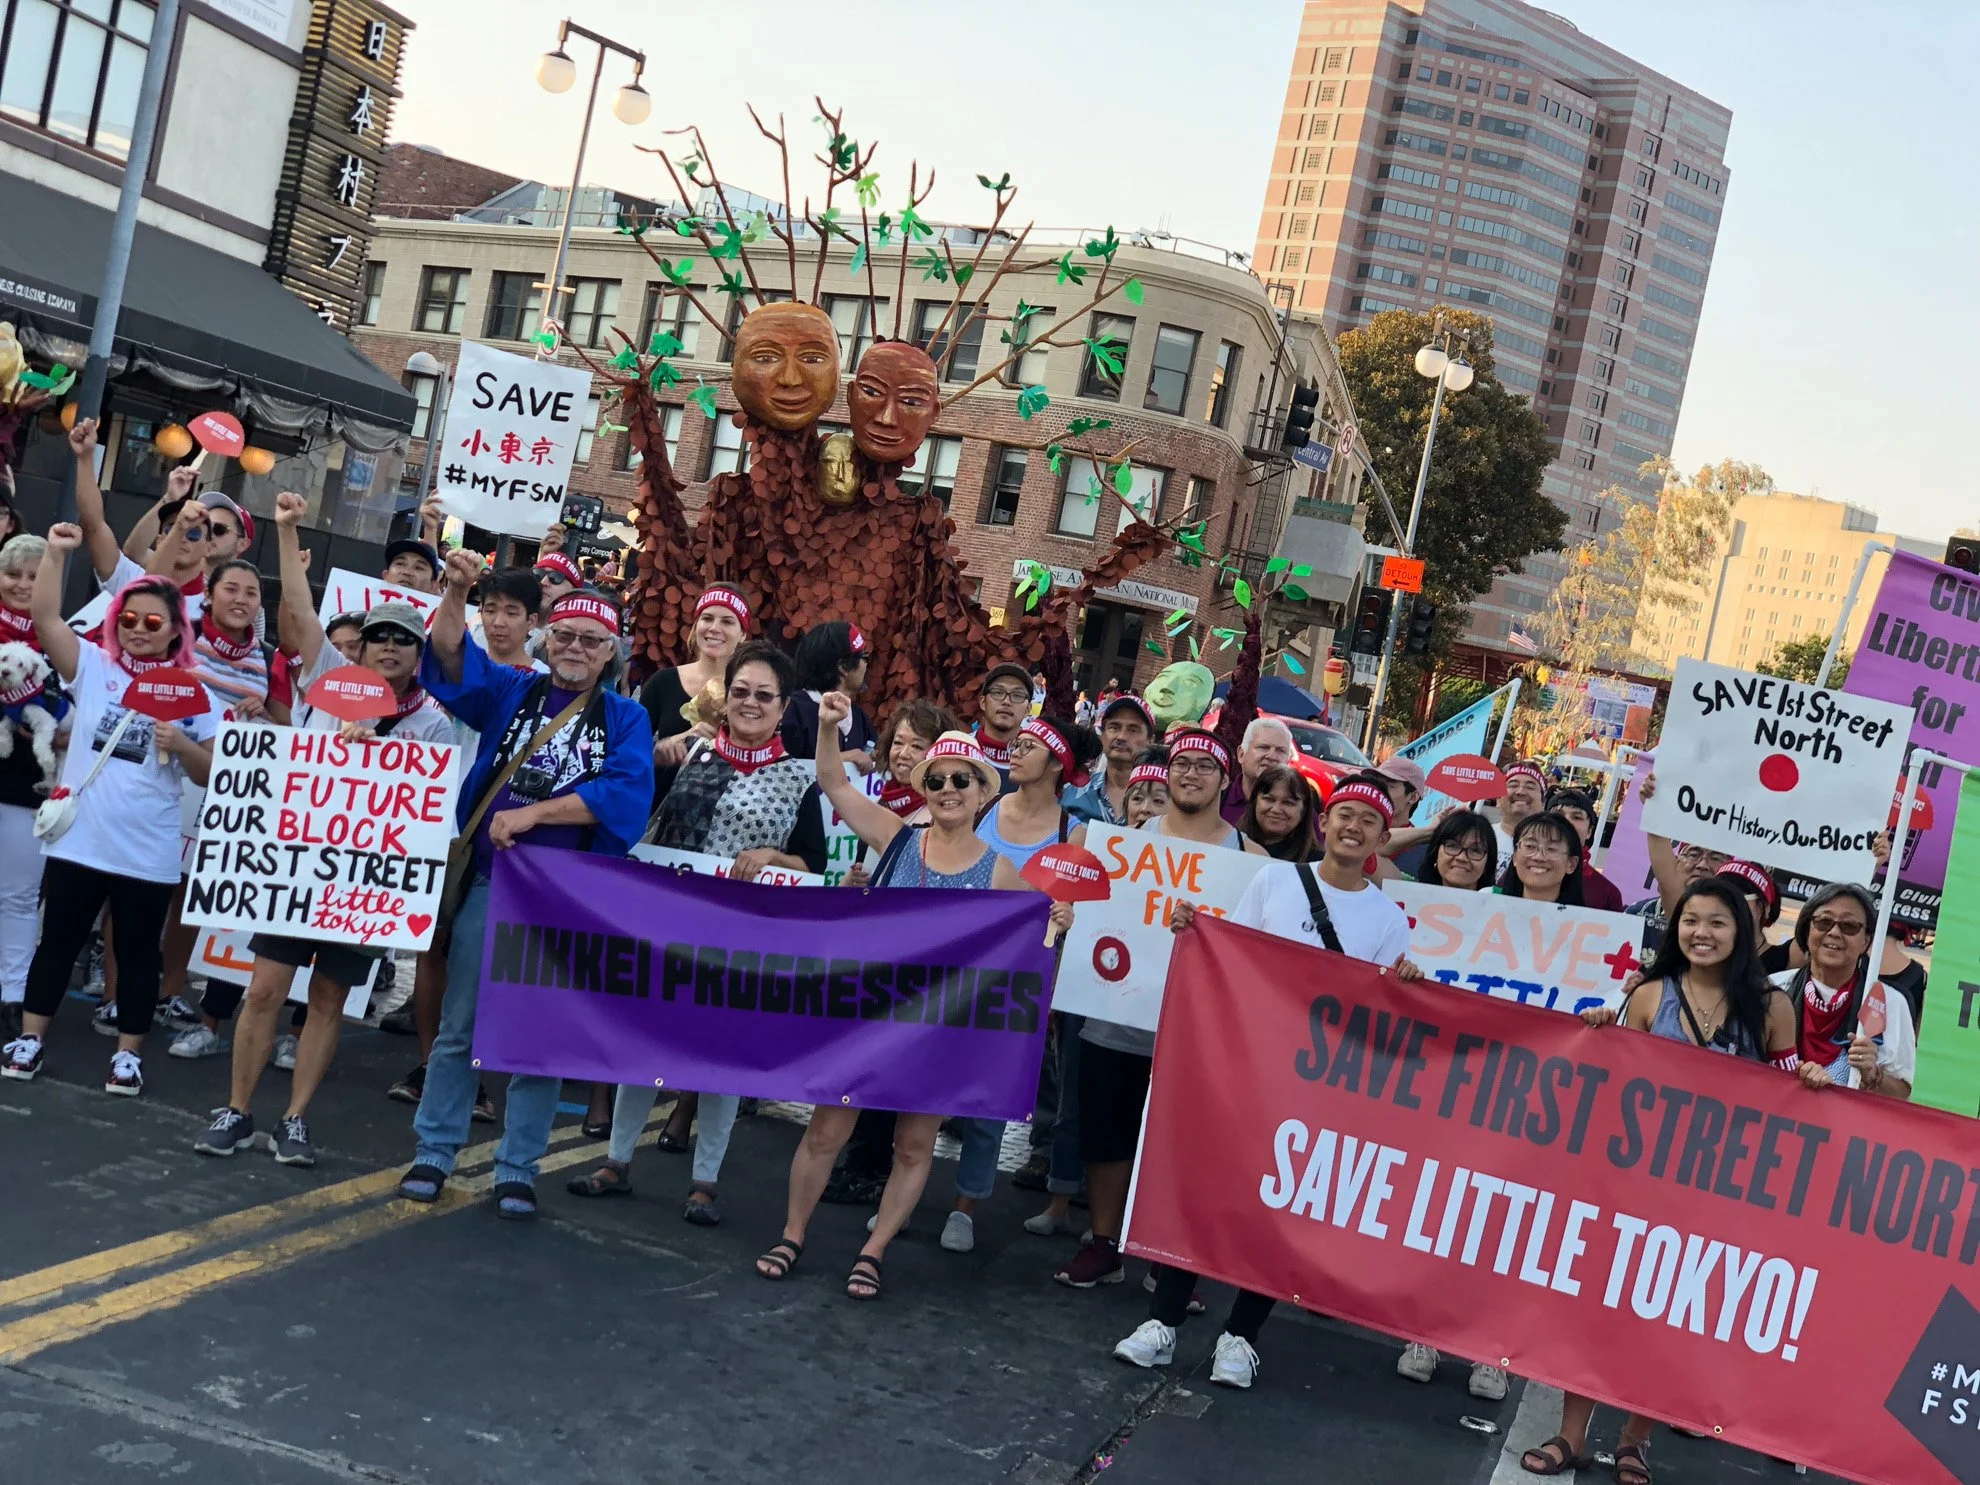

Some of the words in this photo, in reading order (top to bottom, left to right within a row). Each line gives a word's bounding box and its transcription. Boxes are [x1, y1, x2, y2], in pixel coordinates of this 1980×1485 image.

[472, 372, 574, 422] SAVE
[461, 429, 555, 465] 小東京
[1297, 444, 1321, 461] Central
[1320, 450, 1329, 465] Av
[444, 463, 563, 503] #MYFSN
[1385, 568, 1418, 581] DETOUR
[567, 598, 598, 613] LITTLE
[703, 590, 730, 603] LITTLE
[1134, 585, 1178, 606] NATIONAL
[213, 636, 232, 655] SAVE
[153, 684, 174, 695] LITTLE
[324, 679, 341, 692] SAVE
[341, 681, 362, 695] LITTLE
[363, 684, 384, 698] TOKYO
[1693, 678, 1776, 716] SAVE
[1777, 684, 1805, 717] 1st
[1805, 691, 1893, 748] Street
[1911, 685, 1966, 735] for
[222, 729, 277, 760] OUR
[290, 733, 452, 780] HISTORY
[589, 726, 605, 773] 小東京
[725, 746, 748, 763] LITTLE
[937, 741, 967, 756] LITTLE
[1043, 729, 1067, 755] TOKYO
[1181, 737, 1209, 750] LITTLE
[1754, 718, 1842, 764] North
[1142, 765, 1168, 780] LITTLE
[1442, 765, 1457, 777] SAVE
[1456, 767, 1476, 779] LITTLE
[1476, 769, 1495, 782] TOKYO
[214, 768, 272, 799] OUR
[283, 771, 447, 823] FUTURE
[1348, 784, 1379, 798] LITTLE
[203, 805, 267, 834] OUR
[277, 808, 408, 856] BLOCK
[1677, 785, 1727, 825] Our
[1782, 819, 1817, 847] Our
[196, 840, 310, 878] FIRST
[313, 847, 445, 894] STREET
[1040, 855, 1057, 870] SAVE
[1056, 858, 1079, 876] LITTLE
[1078, 865, 1100, 882] TOKYO
[1106, 835, 1206, 893] SAVE
[1747, 867, 1768, 892] TOKYO
[187, 878, 312, 923] NORTH
[316, 883, 406, 917] little
[311, 910, 398, 945] tokyo
[1410, 903, 1609, 991] SAVE
[490, 920, 652, 999] NIKKEI
[661, 940, 1043, 1036] PROGRESSIVES
[1295, 994, 1442, 1109] SAVE
[1438, 1033, 1609, 1155] FIRST
[1606, 1077, 1831, 1217] STREET
[1259, 1119, 1407, 1240] SAVE
[1402, 1158, 1600, 1298] LITTLE
[1602, 1212, 1819, 1363] TOKYO!
